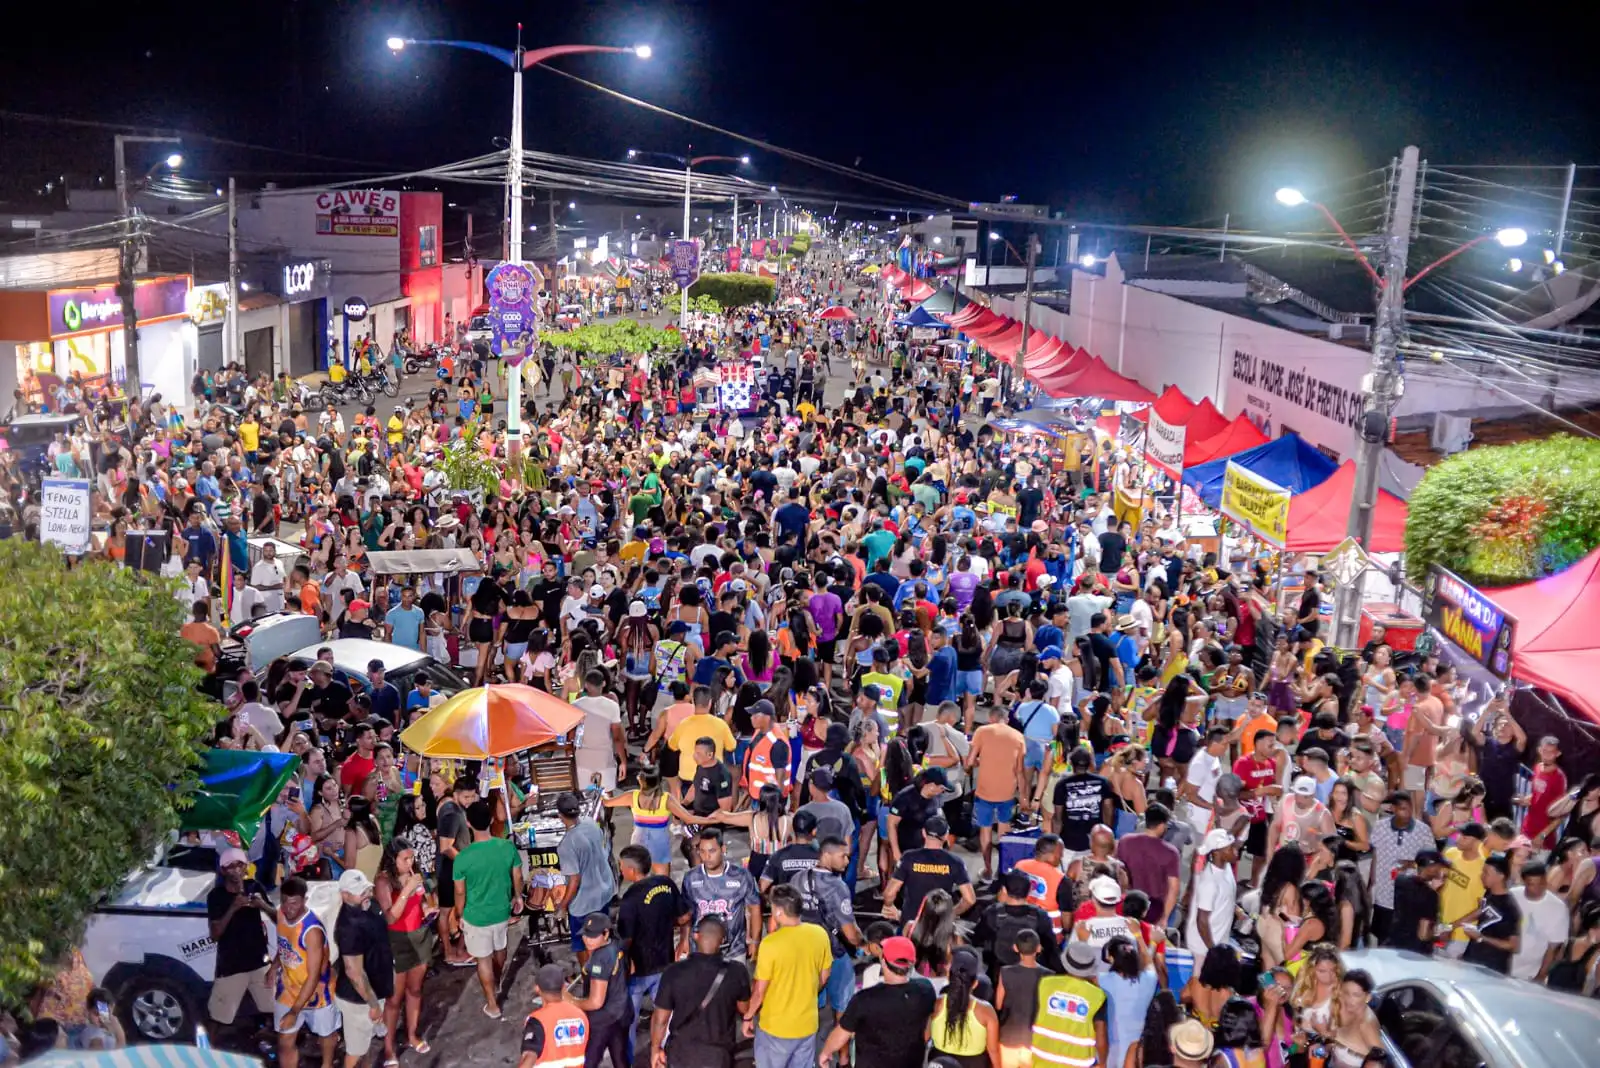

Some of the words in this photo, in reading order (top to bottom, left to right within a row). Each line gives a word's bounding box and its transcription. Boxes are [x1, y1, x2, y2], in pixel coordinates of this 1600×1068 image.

[316, 190, 396, 211] CAWEB
[286, 263, 314, 294] LOOP
[344, 304, 366, 313] LOOP
[1233, 350, 1258, 387] ESCOLA
[1260, 360, 1285, 397] PADRE
[1285, 366, 1307, 406] JOSÉ
[1304, 376, 1317, 411] DE
[1316, 381, 1348, 425] FREITAS
[47, 492, 82, 505] TEMOS
[45, 506, 79, 520] STELLA
[48, 522, 68, 533] LONG
[1482, 607, 1498, 631] DA
